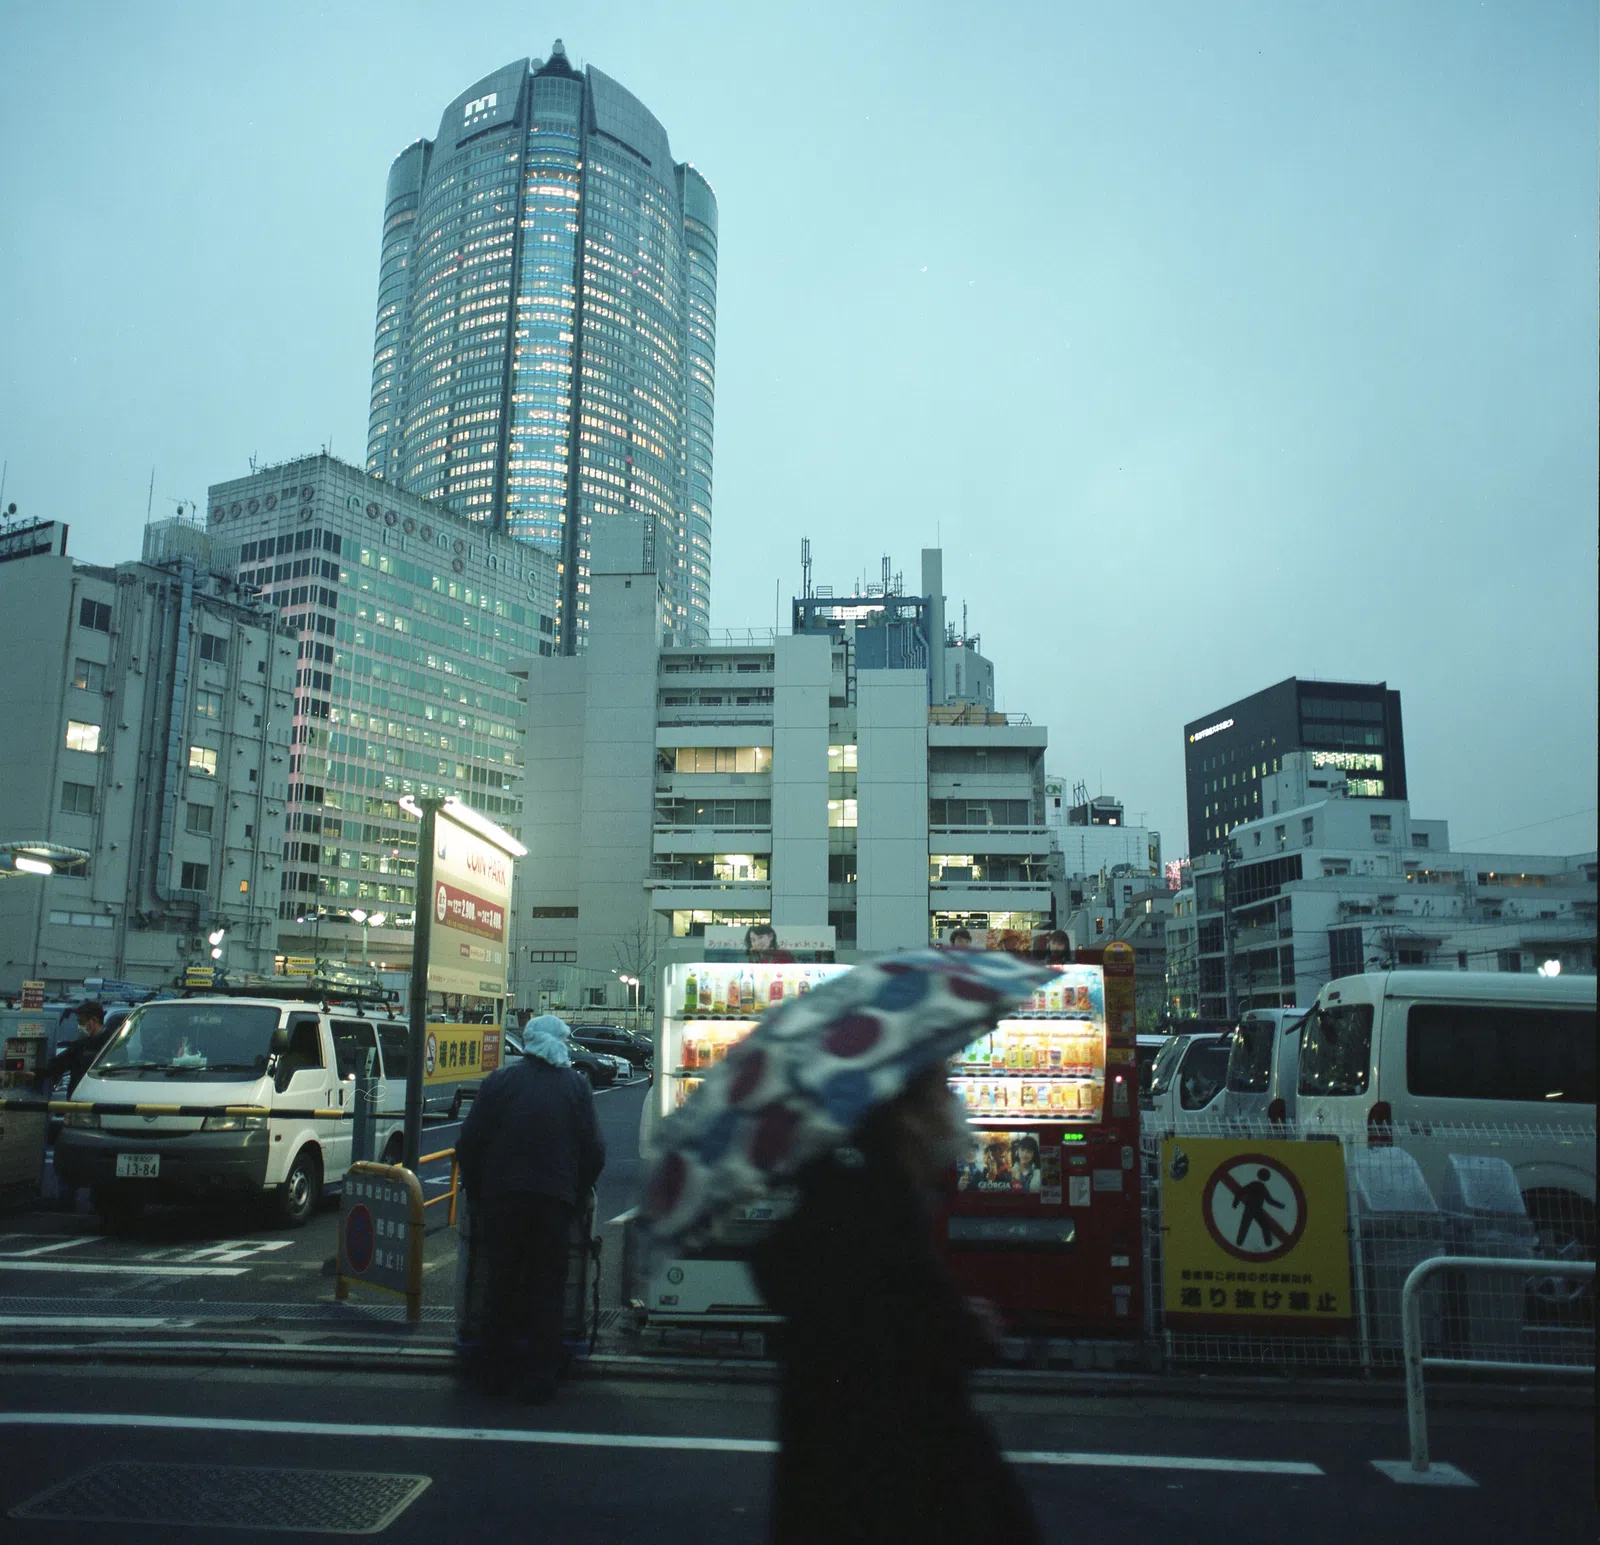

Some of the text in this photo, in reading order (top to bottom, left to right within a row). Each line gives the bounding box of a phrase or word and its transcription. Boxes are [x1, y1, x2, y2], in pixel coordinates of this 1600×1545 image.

[464, 110, 497, 127] MORI
[347, 494, 538, 602] roppongi hills
[126, 1162, 156, 1176] 13-84
[978, 1180, 1011, 1189] GEORGIA
[1181, 1287, 1337, 1311] 通り抜け禁止
